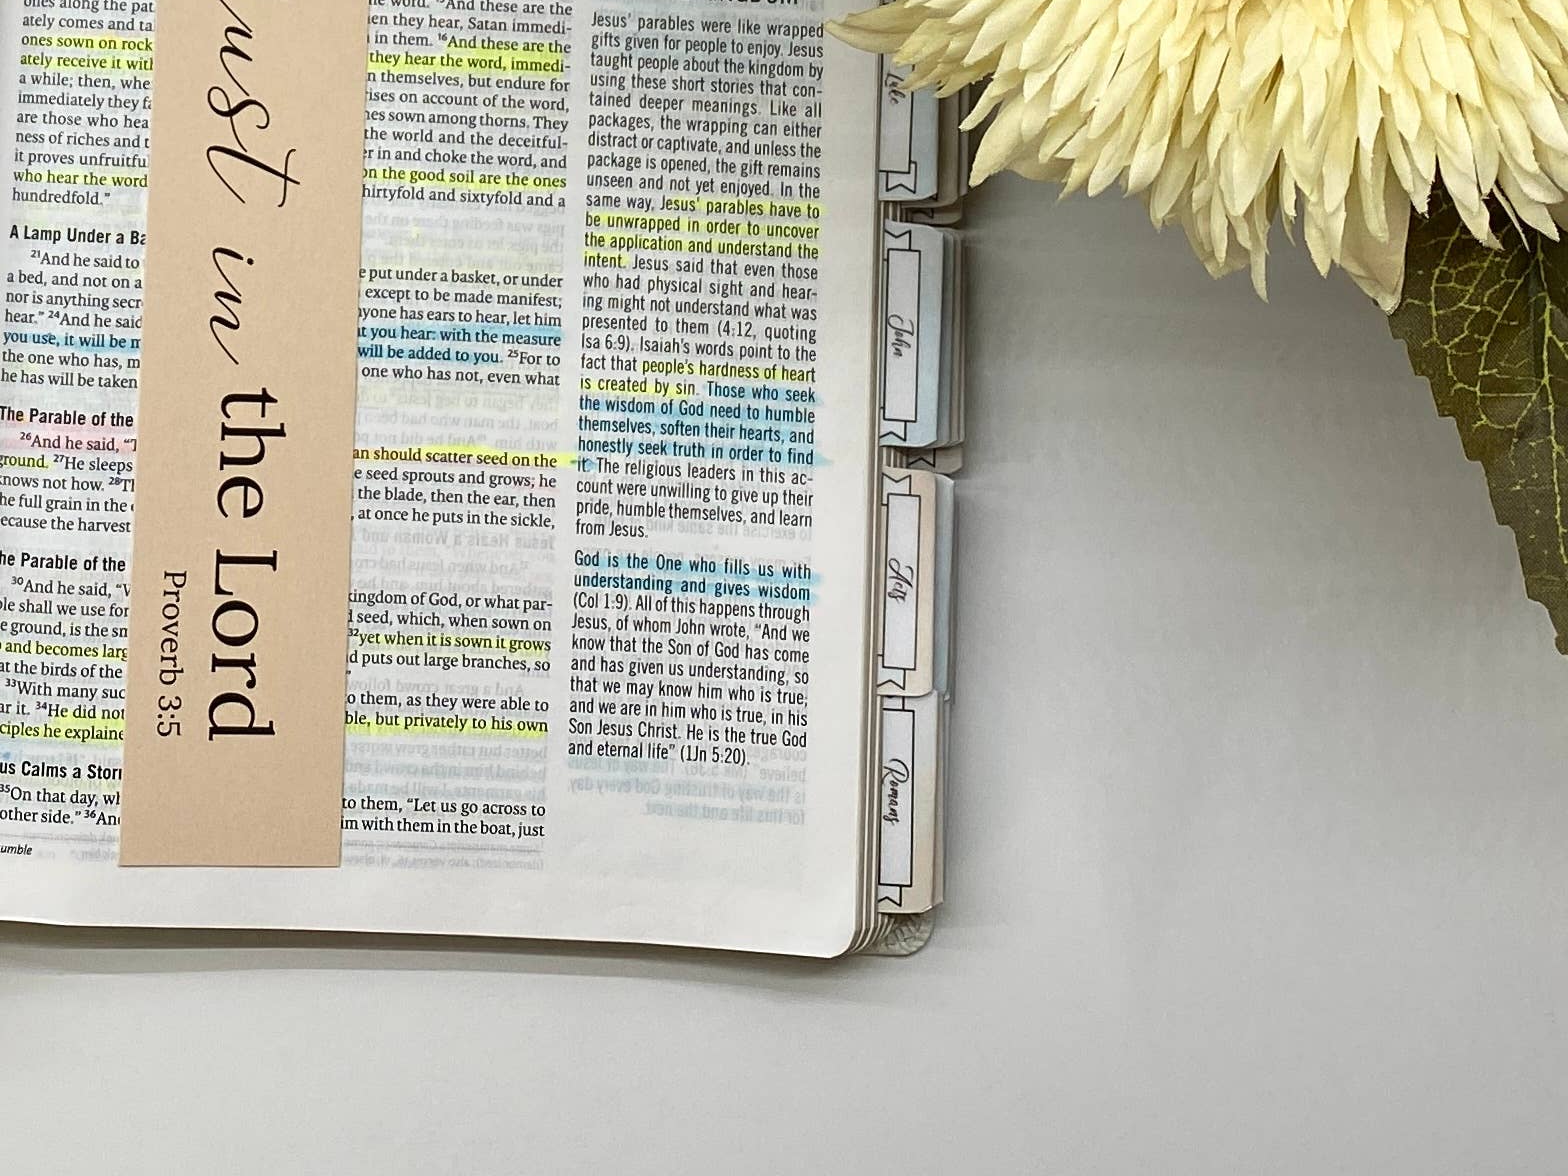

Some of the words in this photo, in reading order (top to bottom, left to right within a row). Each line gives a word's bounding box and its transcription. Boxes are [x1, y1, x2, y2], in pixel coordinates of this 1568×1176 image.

[591, 11, 632, 28] Jesus’
[637, 15, 695, 33] parables
[700, 20, 732, 34] were
[737, 18, 761, 35] like
[766, 22, 825, 41] wrapped
[591, 31, 621, 50] gifts
[624, 32, 659, 52] given
[663, 33, 682, 51] for
[685, 37, 727, 56] people
[730, 38, 744, 55] to
[747, 39, 784, 59] enjoy.
[787, 41, 824, 59] Jesus
[9, 224, 19, 239] A
[23, 224, 62, 245] Lamp
[67, 227, 112, 244] Under
[115, 232, 125, 245] a
[210, 247, 254, 365] in
[887, 313, 915, 358] John
[29, 407, 87, 426] Parable
[91, 411, 107, 427] of
[110, 411, 134, 428] the
[217, 388, 286, 518] the
[20, 551, 78, 571] Parable
[83, 555, 99, 571] of
[102, 556, 126, 573] the
[574, 549, 600, 567] God
[607, 555, 619, 568] is
[626, 552, 649, 570] the
[655, 553, 683, 572] One
[689, 556, 717, 574] who
[724, 558, 751, 576] fills
[757, 562, 774, 577] us
[781, 563, 812, 581] with
[887, 557, 914, 603] Acts
[574, 571, 673, 595] understanding
[680, 576, 706, 594] and
[714, 578, 750, 598] gives
[758, 581, 810, 601] wisdom
[159, 571, 187, 685] Proverb
[209, 549, 277, 741] Lord
[157, 696, 181, 736] 3:5
[568, 739, 593, 756] and
[597, 740, 643, 759] eternal
[647, 742, 676, 760] life”
[680, 744, 707, 763] (1Jn
[711, 746, 750, 767] 5:20).
[881, 758, 911, 824] Romans
